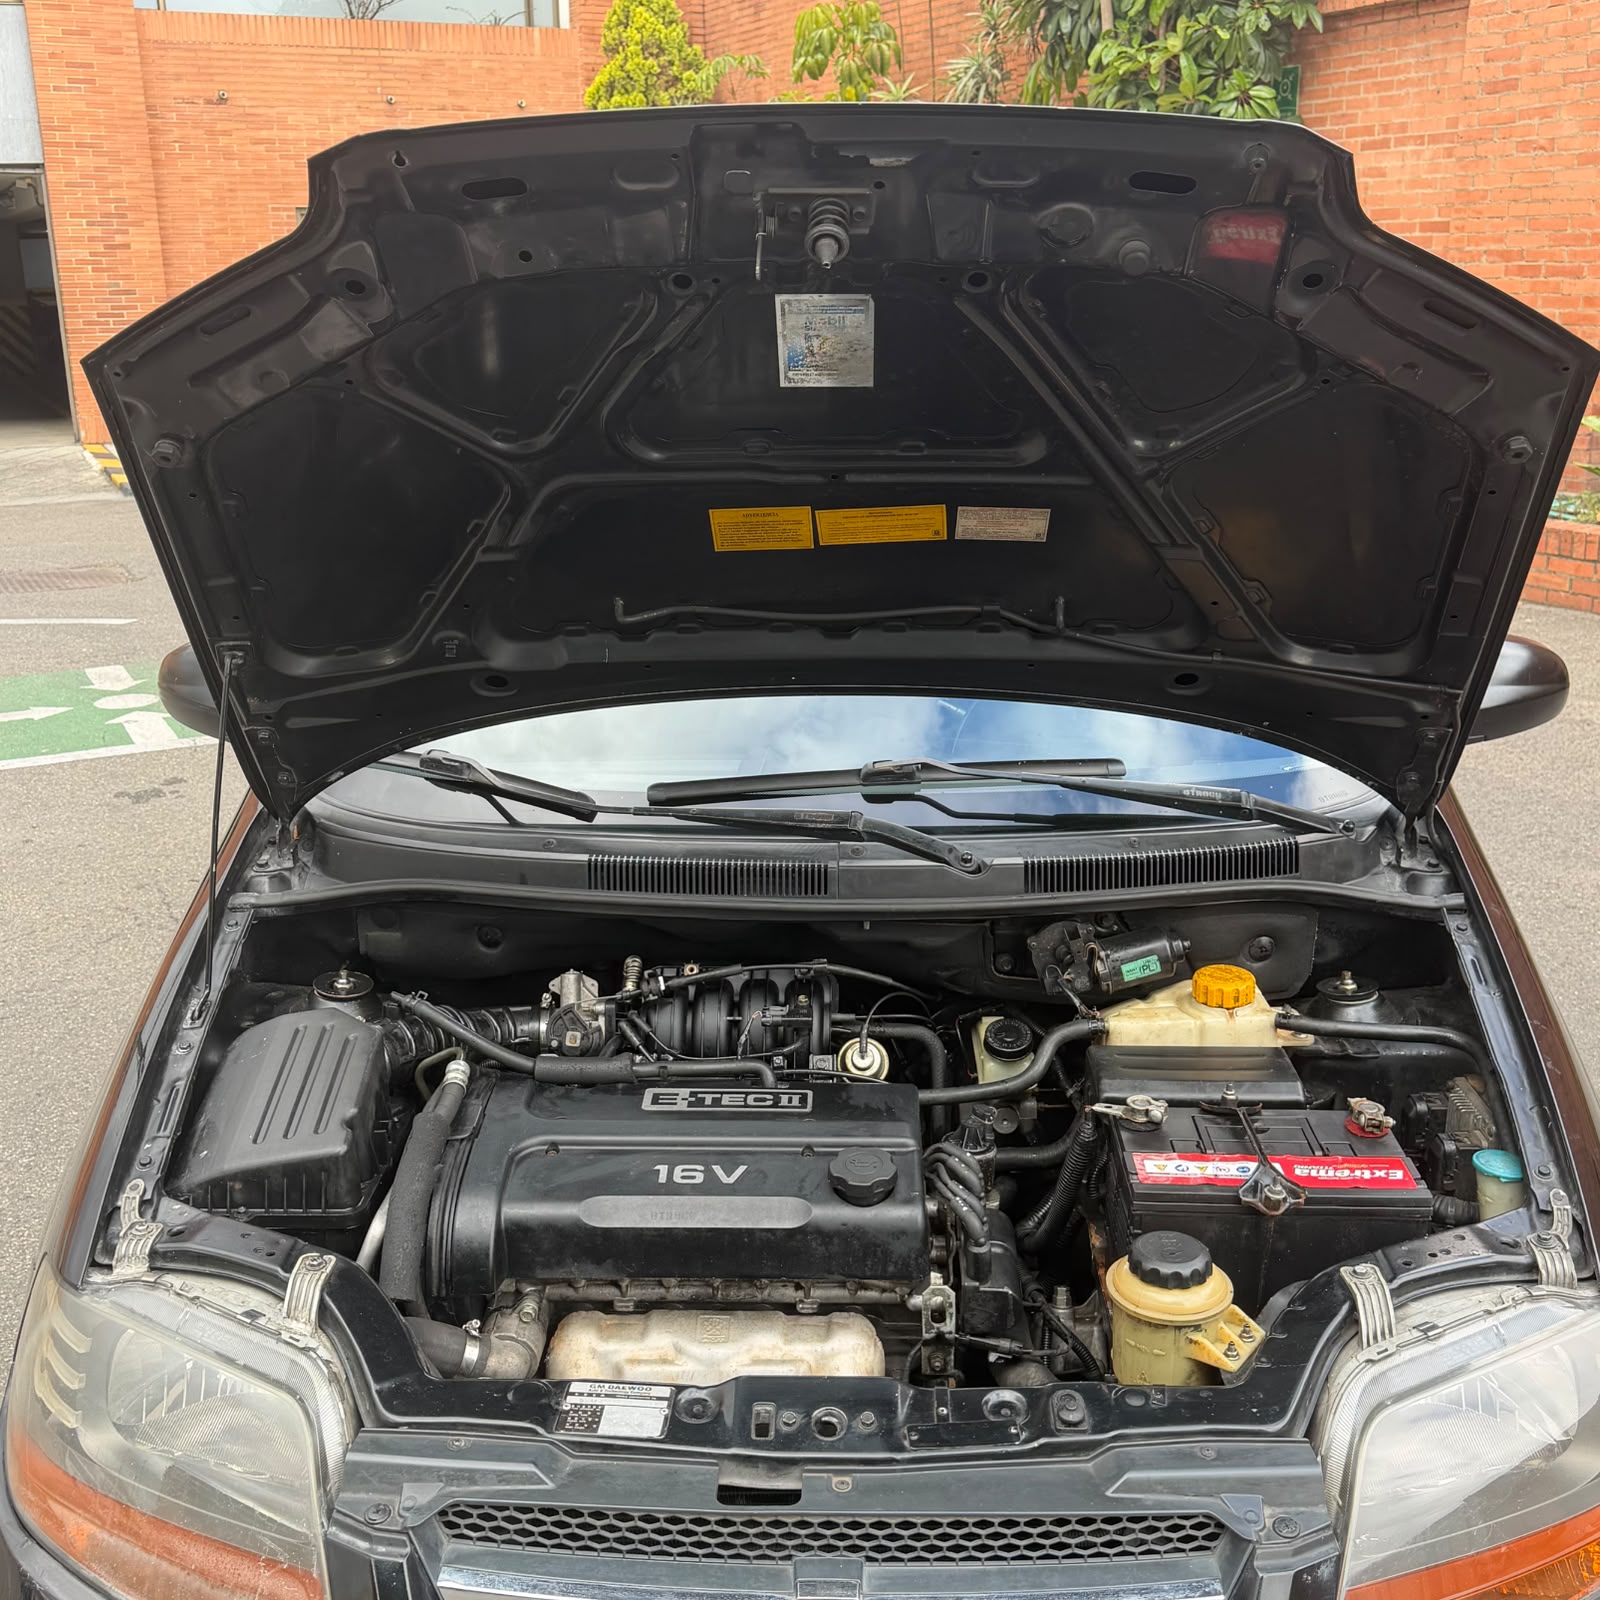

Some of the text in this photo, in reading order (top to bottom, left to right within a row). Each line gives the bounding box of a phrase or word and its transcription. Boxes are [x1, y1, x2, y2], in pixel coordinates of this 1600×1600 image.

[651, 1091, 802, 1107] E-TEC II
[1294, 1168, 1404, 1180] Extrema
